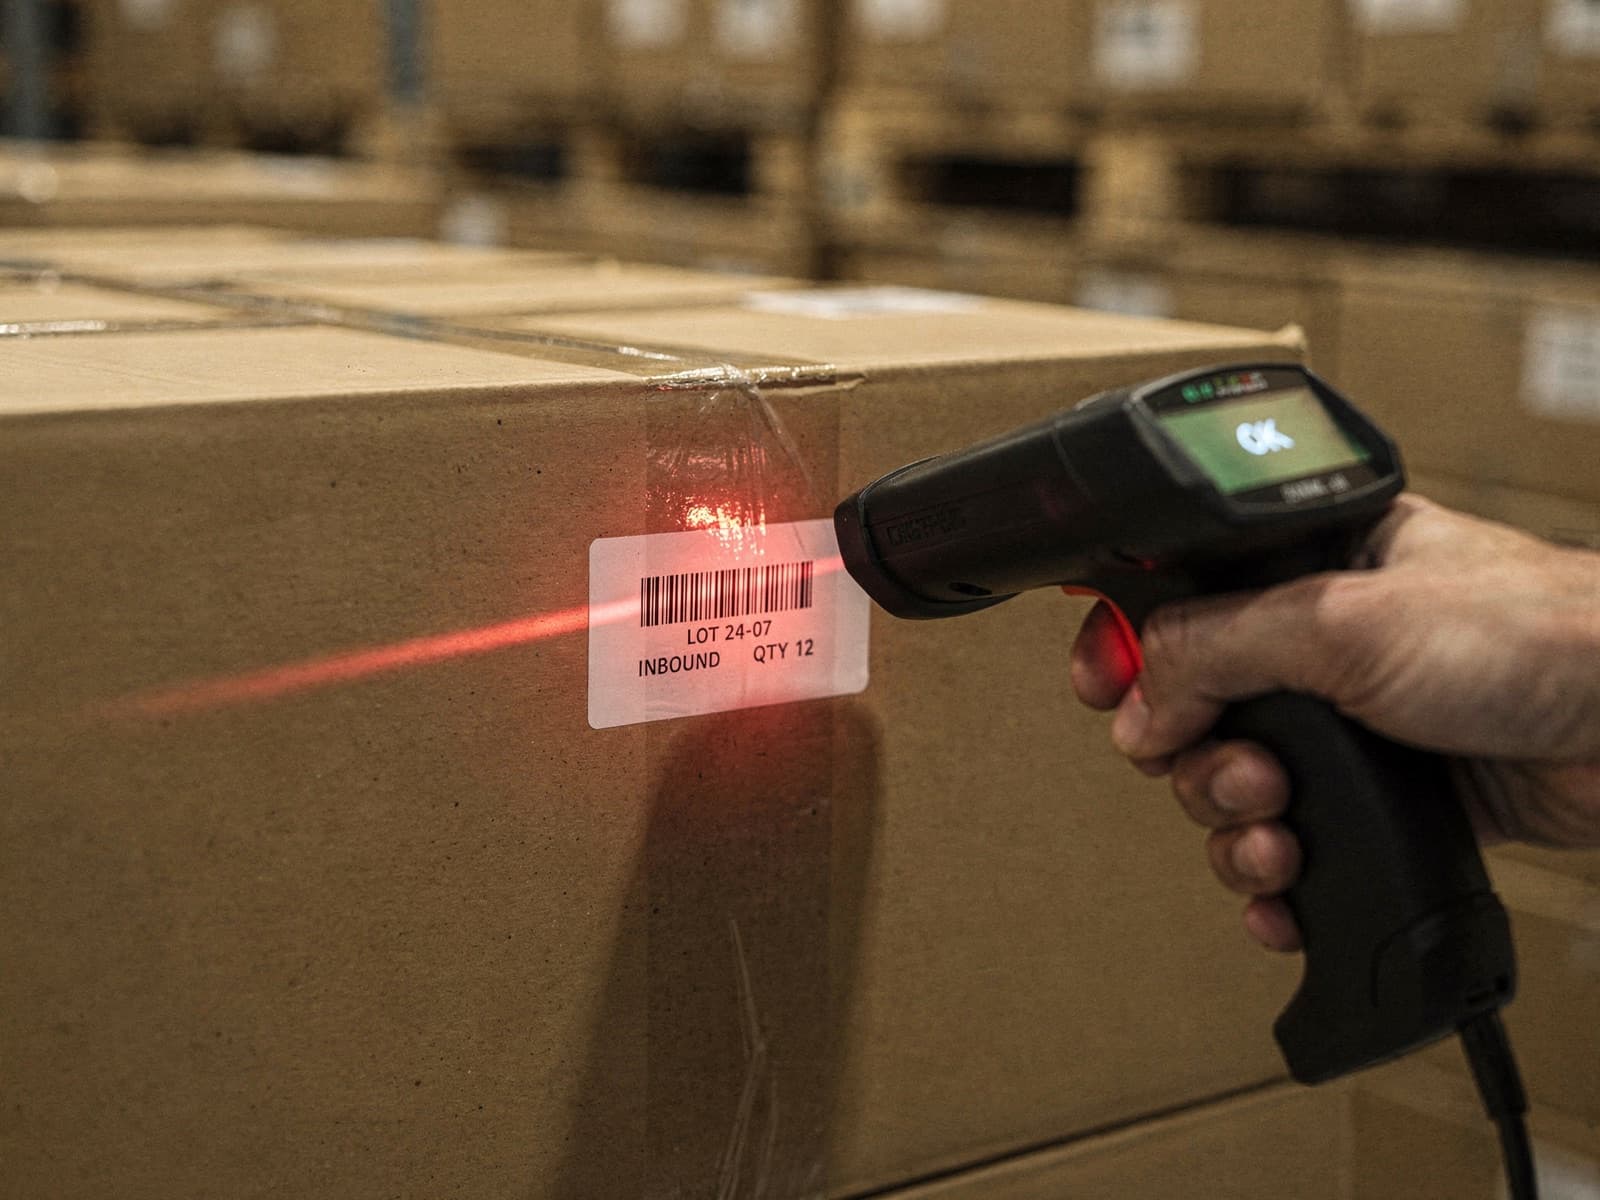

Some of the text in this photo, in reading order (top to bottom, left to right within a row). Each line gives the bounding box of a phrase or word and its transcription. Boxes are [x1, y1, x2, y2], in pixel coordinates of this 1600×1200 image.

[1236, 418, 1295, 455] OK
[687, 620, 773, 644] LOT 24-07
[638, 638, 814, 677] INBOUND QTY 12
